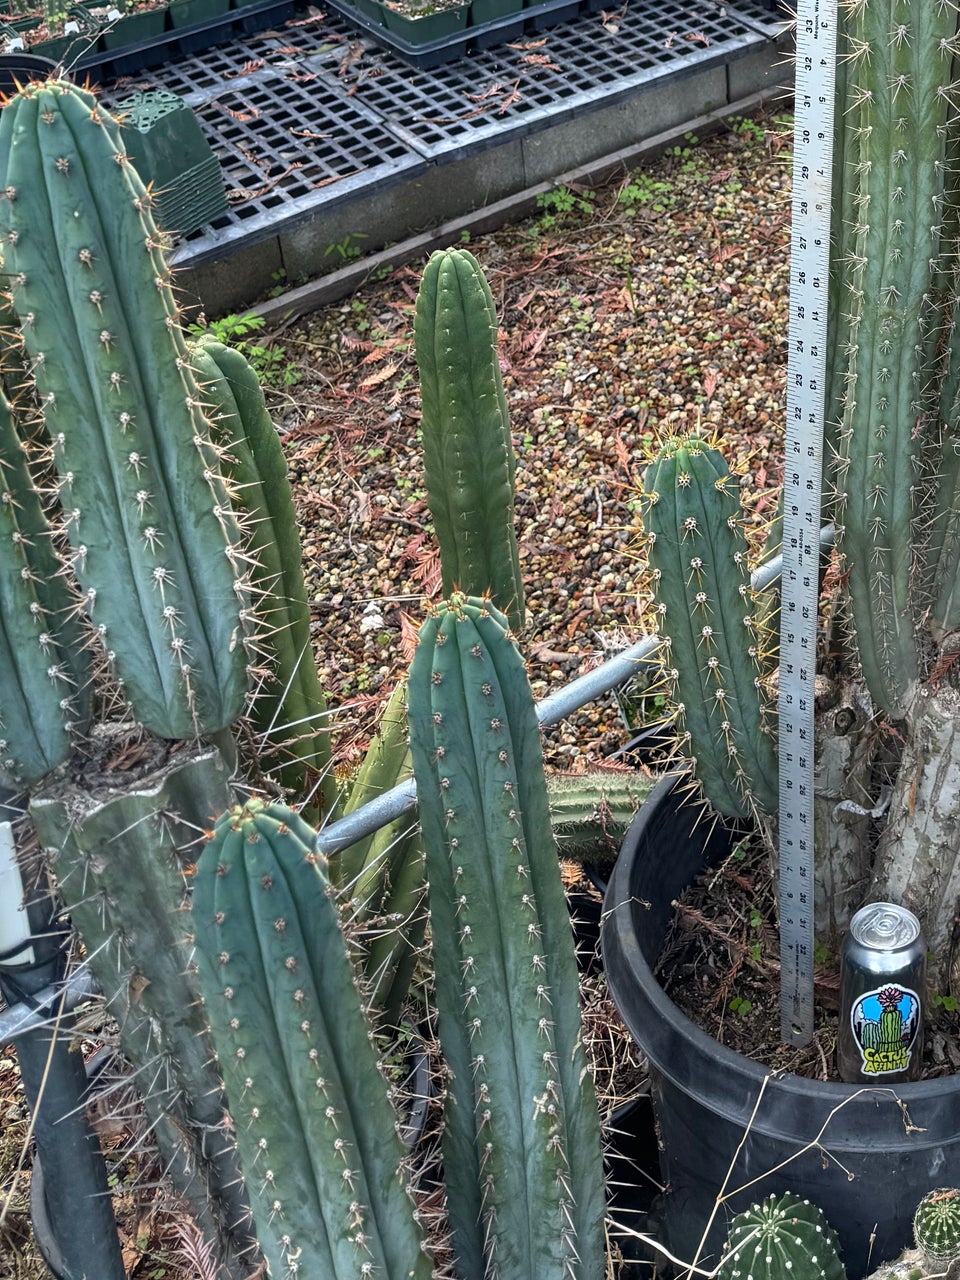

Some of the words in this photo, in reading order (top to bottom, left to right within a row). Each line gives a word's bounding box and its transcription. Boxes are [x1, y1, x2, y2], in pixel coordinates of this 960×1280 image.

[806, 20, 813, 33] 33
[805, 58, 812, 70] 32
[804, 96, 811, 108] 31
[803, 131, 810, 143] 30
[802, 167, 808, 179] 29
[801, 202, 808, 214] 28
[800, 238, 806, 249] 27
[799, 272, 806, 284] 26
[813, 277, 820, 288] 10
[798, 306, 804, 318] 25
[812, 312, 818, 320] 11
[797, 341, 803, 352] 24
[811, 346, 817, 356] 12
[796, 374, 802, 386] 23
[810, 380, 816, 390] 13
[795, 408, 801, 419] 22
[809, 413, 815, 423] 14
[794, 442, 800, 452] 21
[808, 446, 814, 456] 15
[793, 474, 799, 486] 20
[807, 480, 813, 490] 16
[792, 506, 798, 516] 19
[806, 512, 812, 522] 17
[791, 538, 797, 548] 18
[804, 544, 810, 554] 18
[790, 571, 796, 580] 17
[804, 577, 810, 586] 19
[789, 602, 795, 612] 16
[802, 607, 808, 618] 20
[788, 634, 794, 642] 15
[802, 638, 808, 648] 21
[787, 664, 793, 674] 14
[801, 669, 806, 680] 22
[787, 695, 792, 704] 13
[800, 699, 806, 710] 23
[787, 724, 792, 733] 12
[800, 729, 806, 739] 24
[800, 758, 806, 768] 25
[787, 780, 792, 789] 10
[800, 785, 806, 796] 26
[800, 813, 806, 823] 27
[800, 840, 806, 850] 28
[800, 867, 806, 876] 29
[800, 893, 806, 903] 30
[800, 919, 806, 928] 31
[800, 945, 806, 955] 32
[864, 1047, 906, 1062] CACTUS
[864, 1056, 909, 1072] AFFINITY
